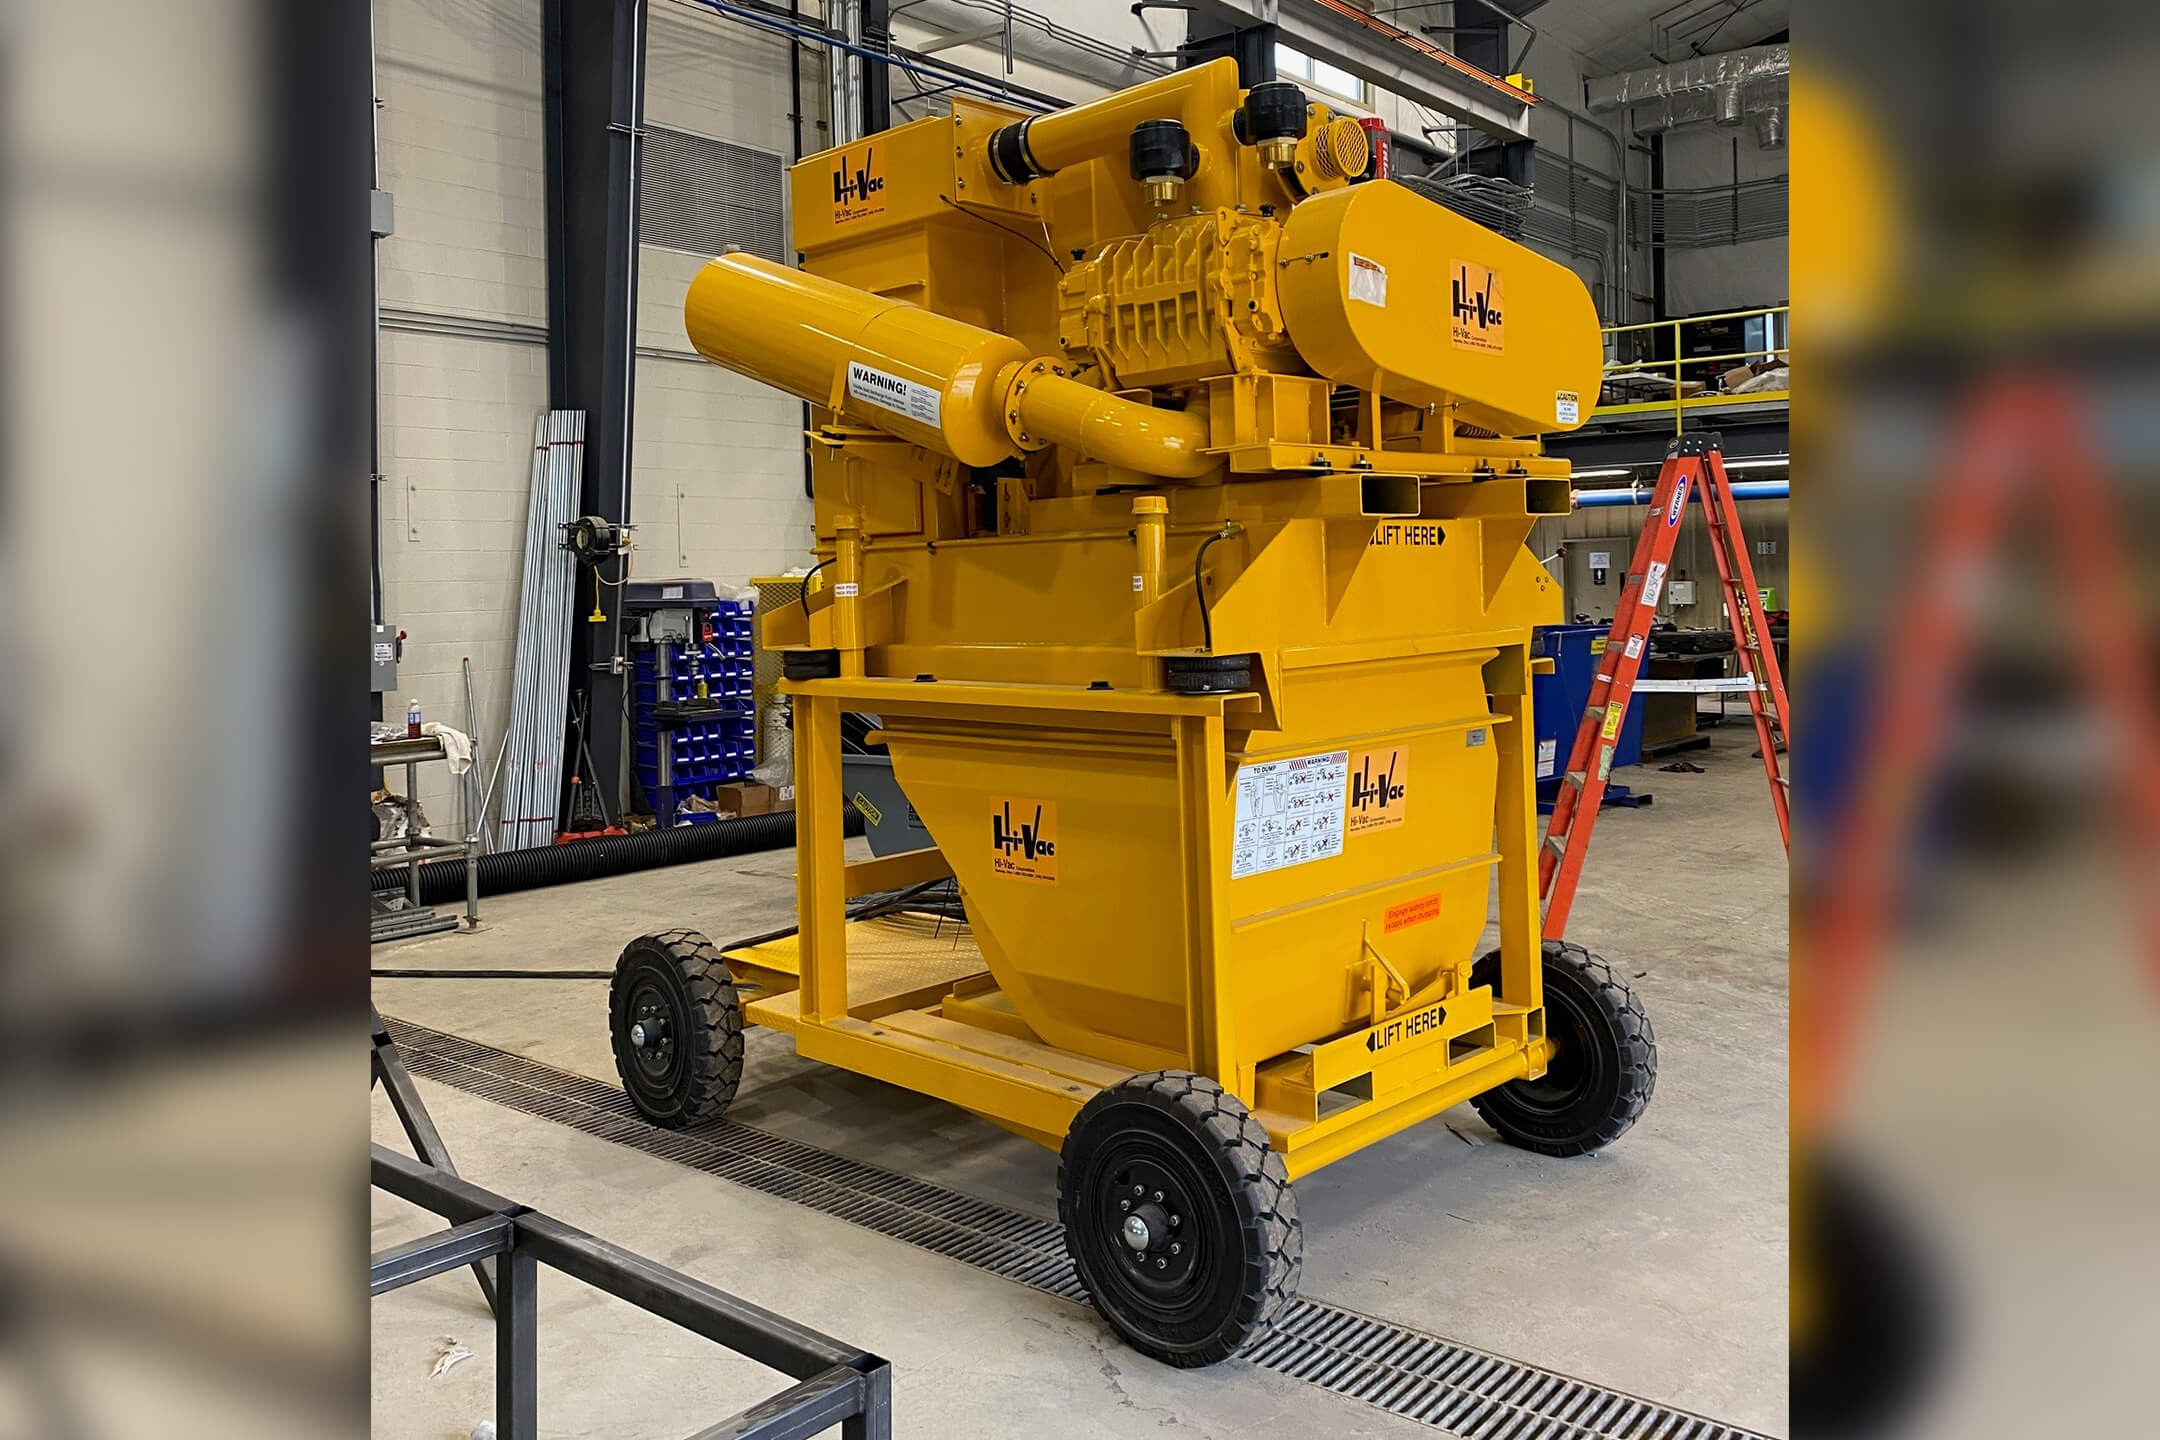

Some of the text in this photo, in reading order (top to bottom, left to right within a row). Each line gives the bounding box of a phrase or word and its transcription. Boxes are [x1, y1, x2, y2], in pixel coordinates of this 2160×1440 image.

[833, 147, 884, 206] Hi-Vac
[1452, 265, 1502, 329] Hi-Vac
[1452, 326, 1470, 339] Hi-Vac
[853, 366, 907, 396] WARNING!
[1671, 485, 1684, 516] WERNER
[1375, 525, 1436, 545] LIFT HERE
[1253, 765, 1277, 774] TO DUMP
[1352, 751, 1404, 811] Hi-Vac
[993, 801, 1055, 860] Hi-Vac
[1350, 815, 1369, 827] Hi-Vac
[994, 858, 1015, 870] Hi-Vac
[1376, 1008, 1437, 1050] LIFT HERE
